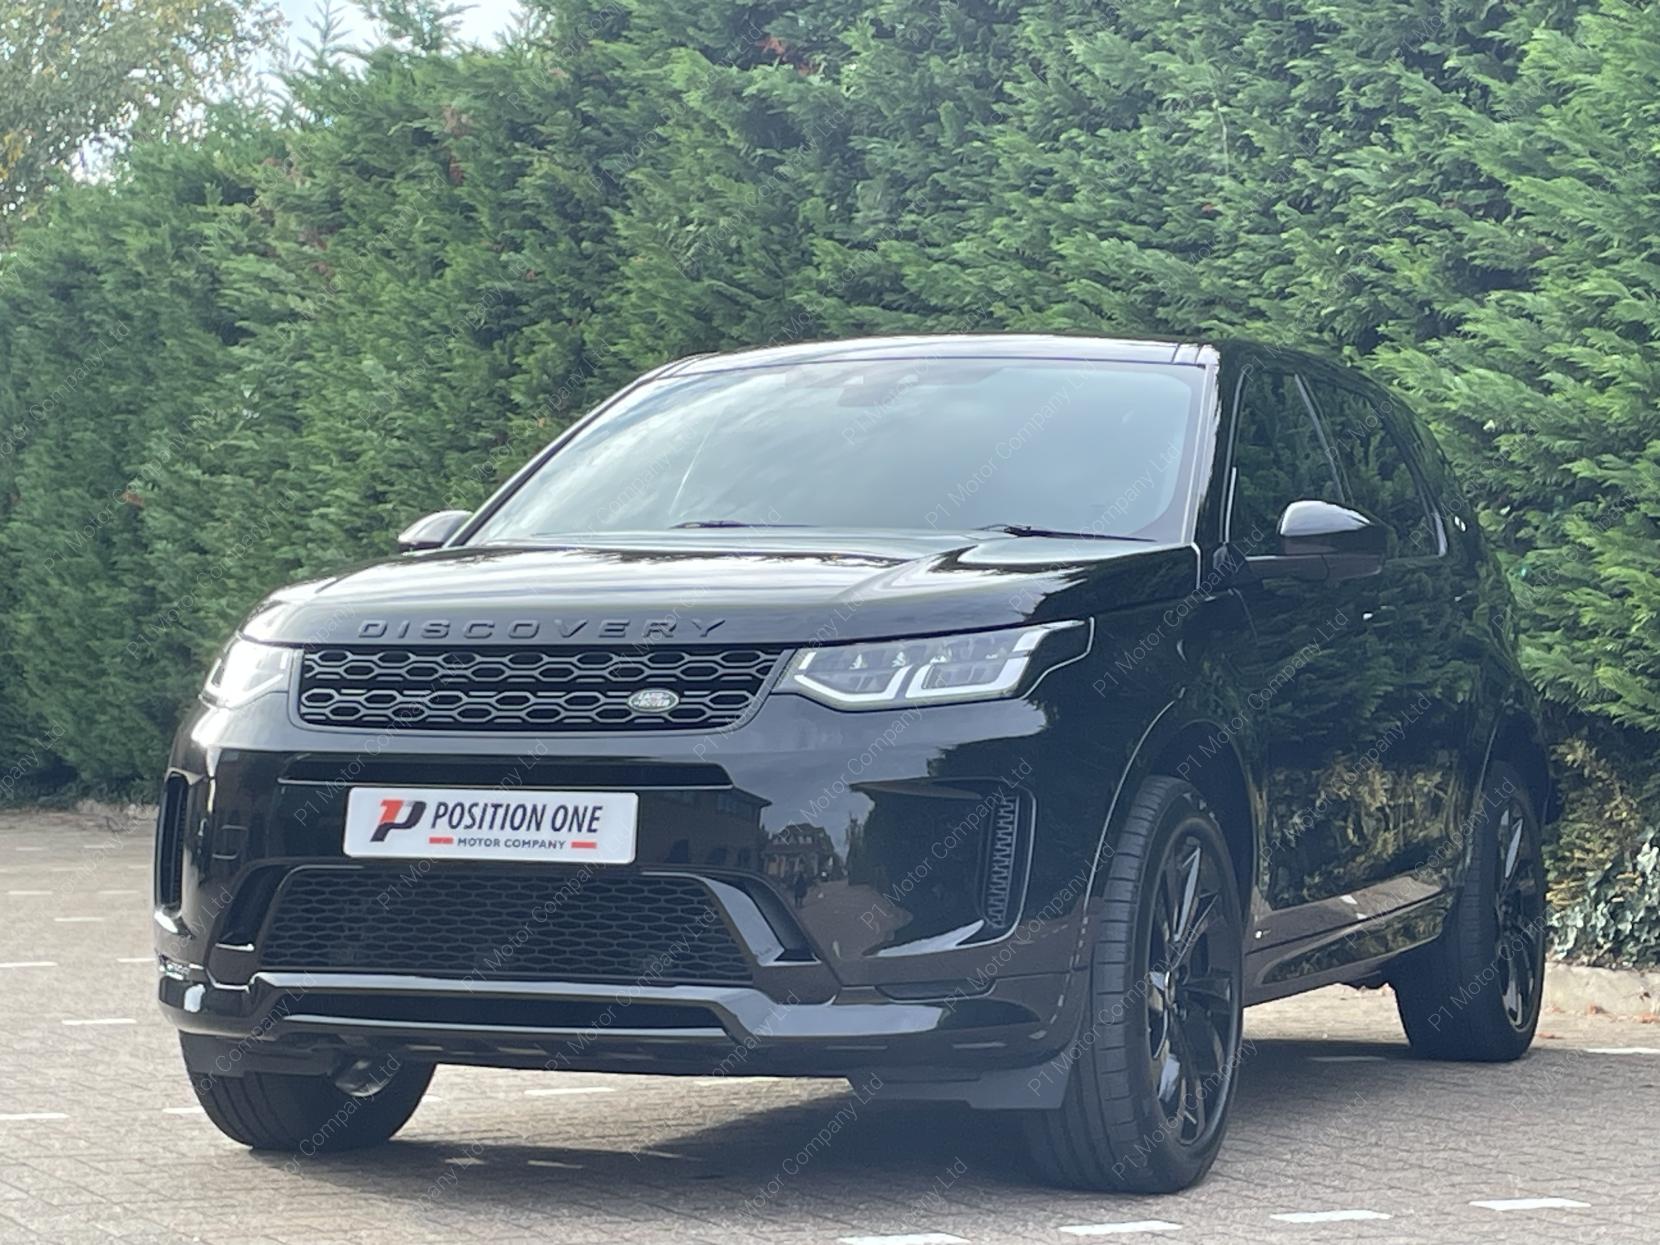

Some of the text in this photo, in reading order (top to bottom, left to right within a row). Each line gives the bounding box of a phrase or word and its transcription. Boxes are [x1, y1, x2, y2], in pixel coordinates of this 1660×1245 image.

[358, 618, 726, 639] DISCOVERY
[431, 801, 603, 833] POSITION ONE
[457, 837, 566, 849] MOTOR COMPANY
